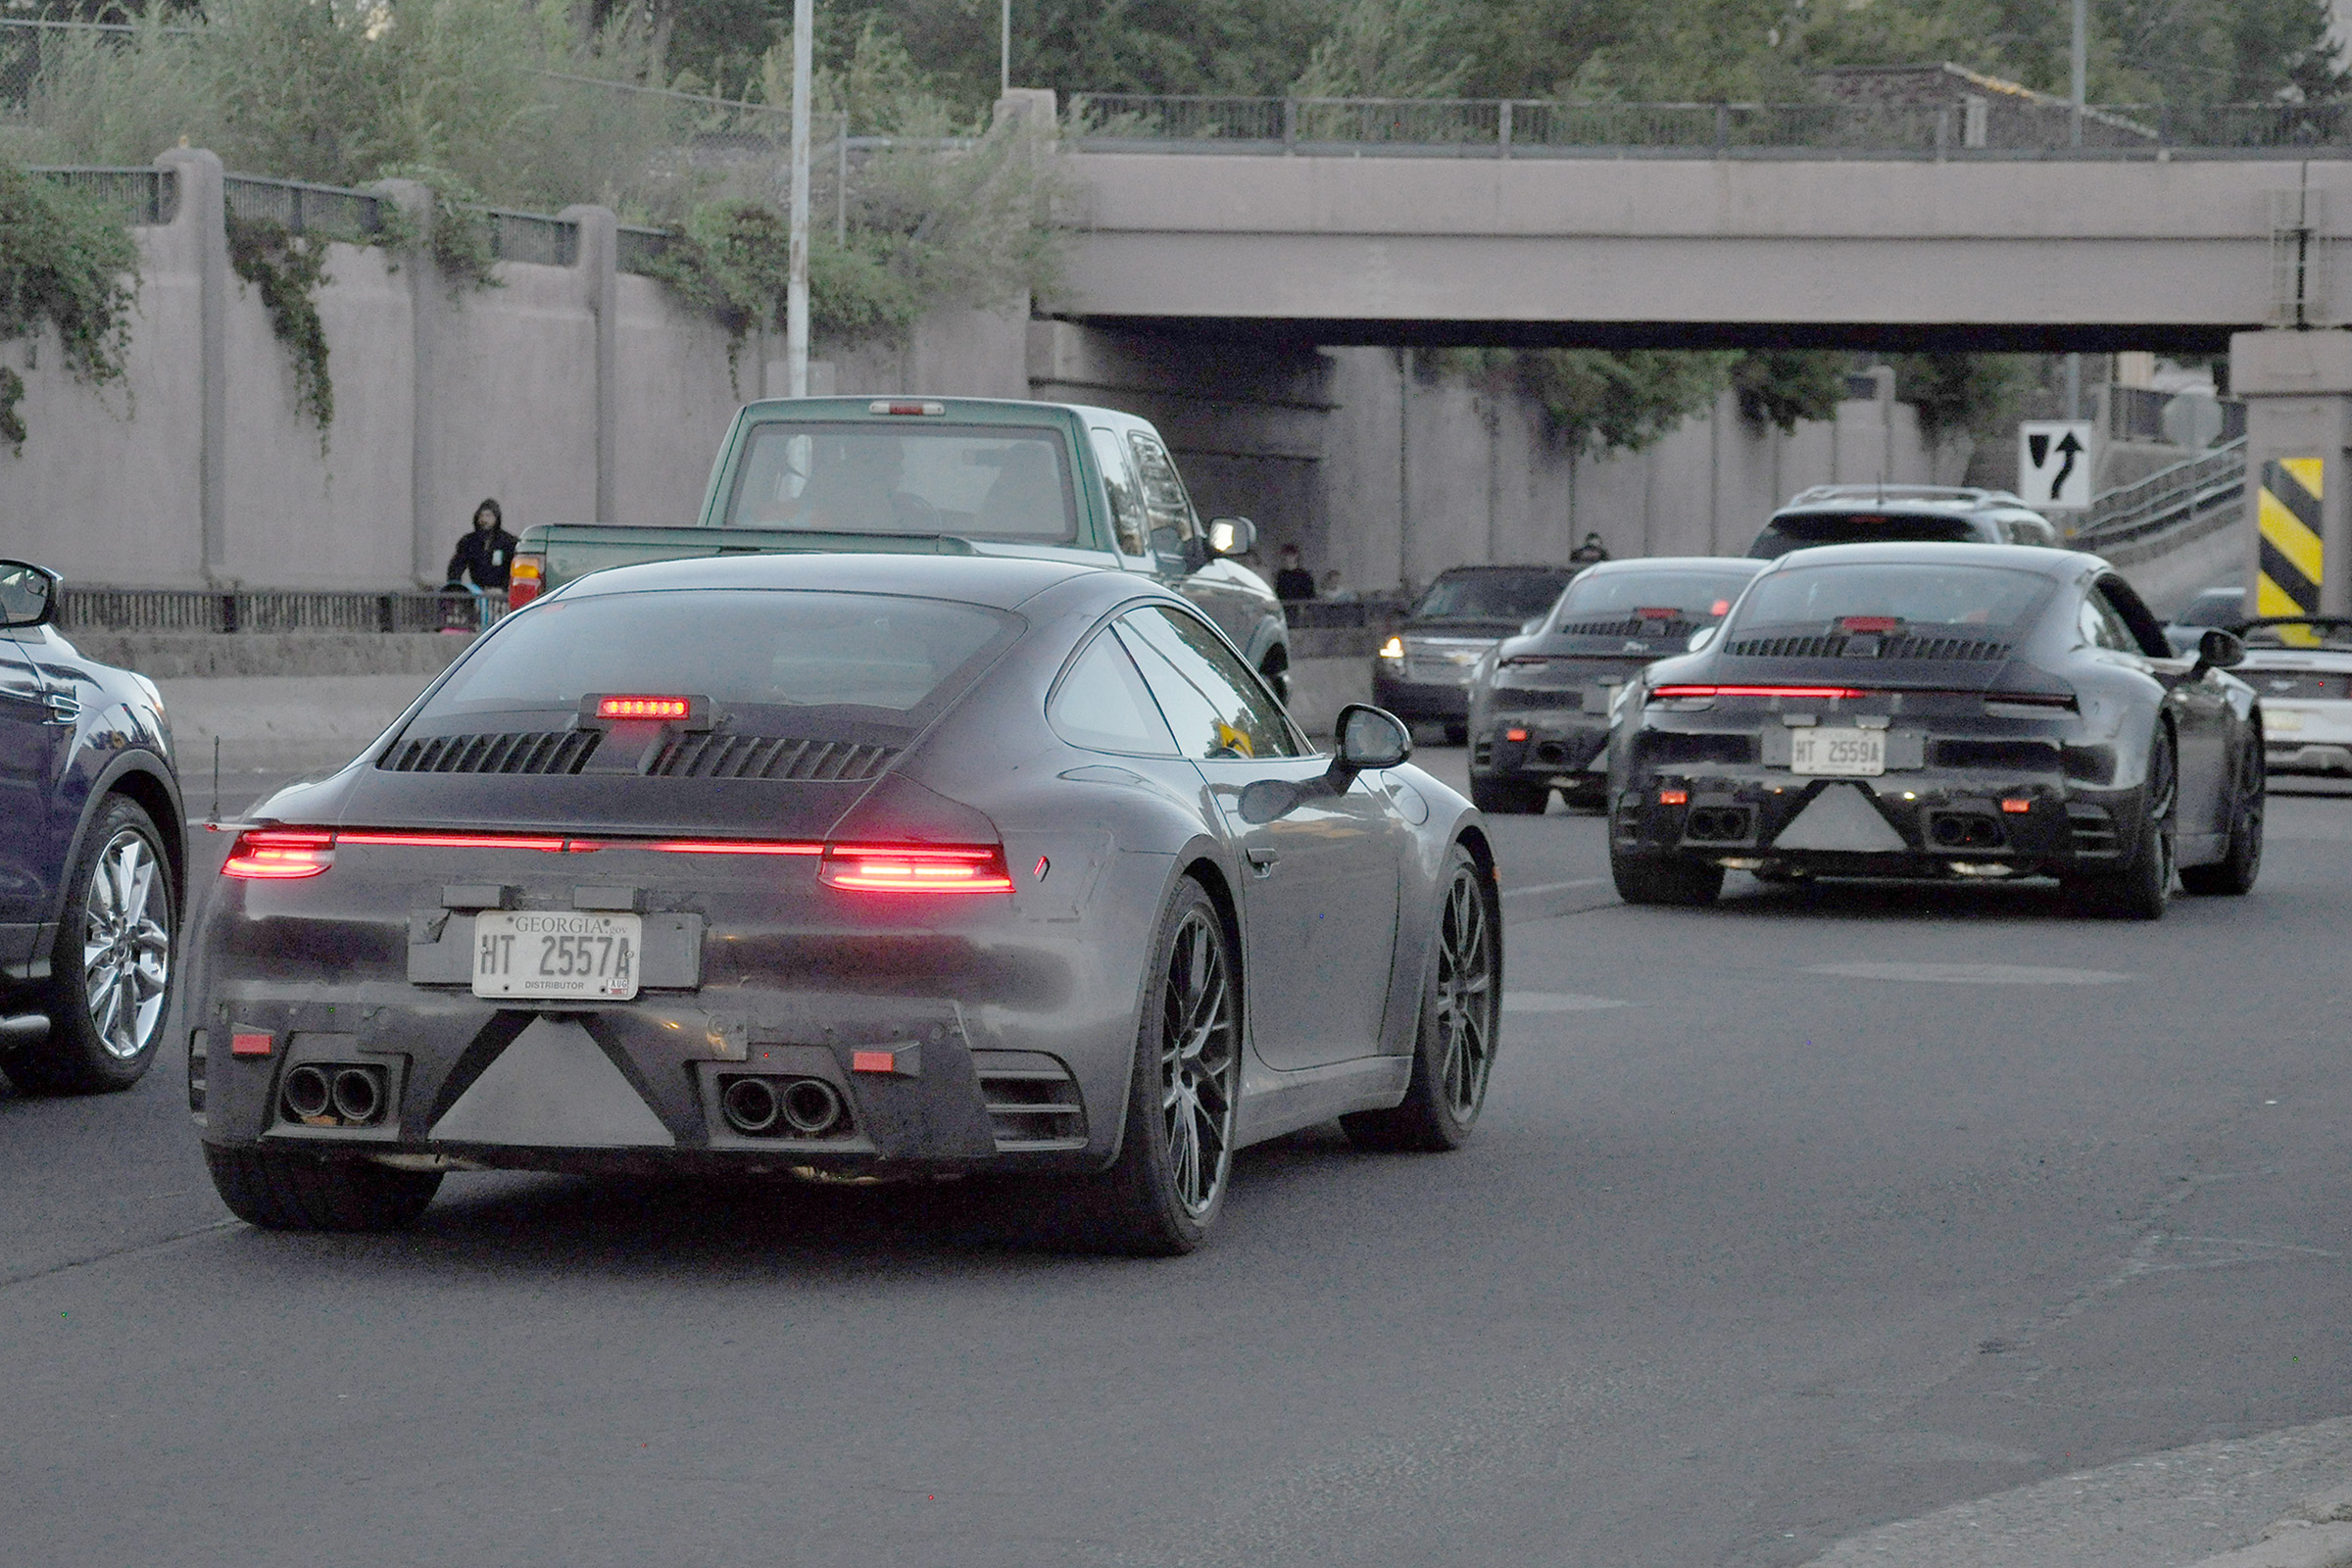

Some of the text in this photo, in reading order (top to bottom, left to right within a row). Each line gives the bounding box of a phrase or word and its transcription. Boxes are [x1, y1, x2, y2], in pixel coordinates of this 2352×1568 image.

[1796, 740, 1879, 762] HT 2559A
[480, 934, 631, 978] HT 2557A
[524, 981, 584, 990] DISTRIBUTOR
